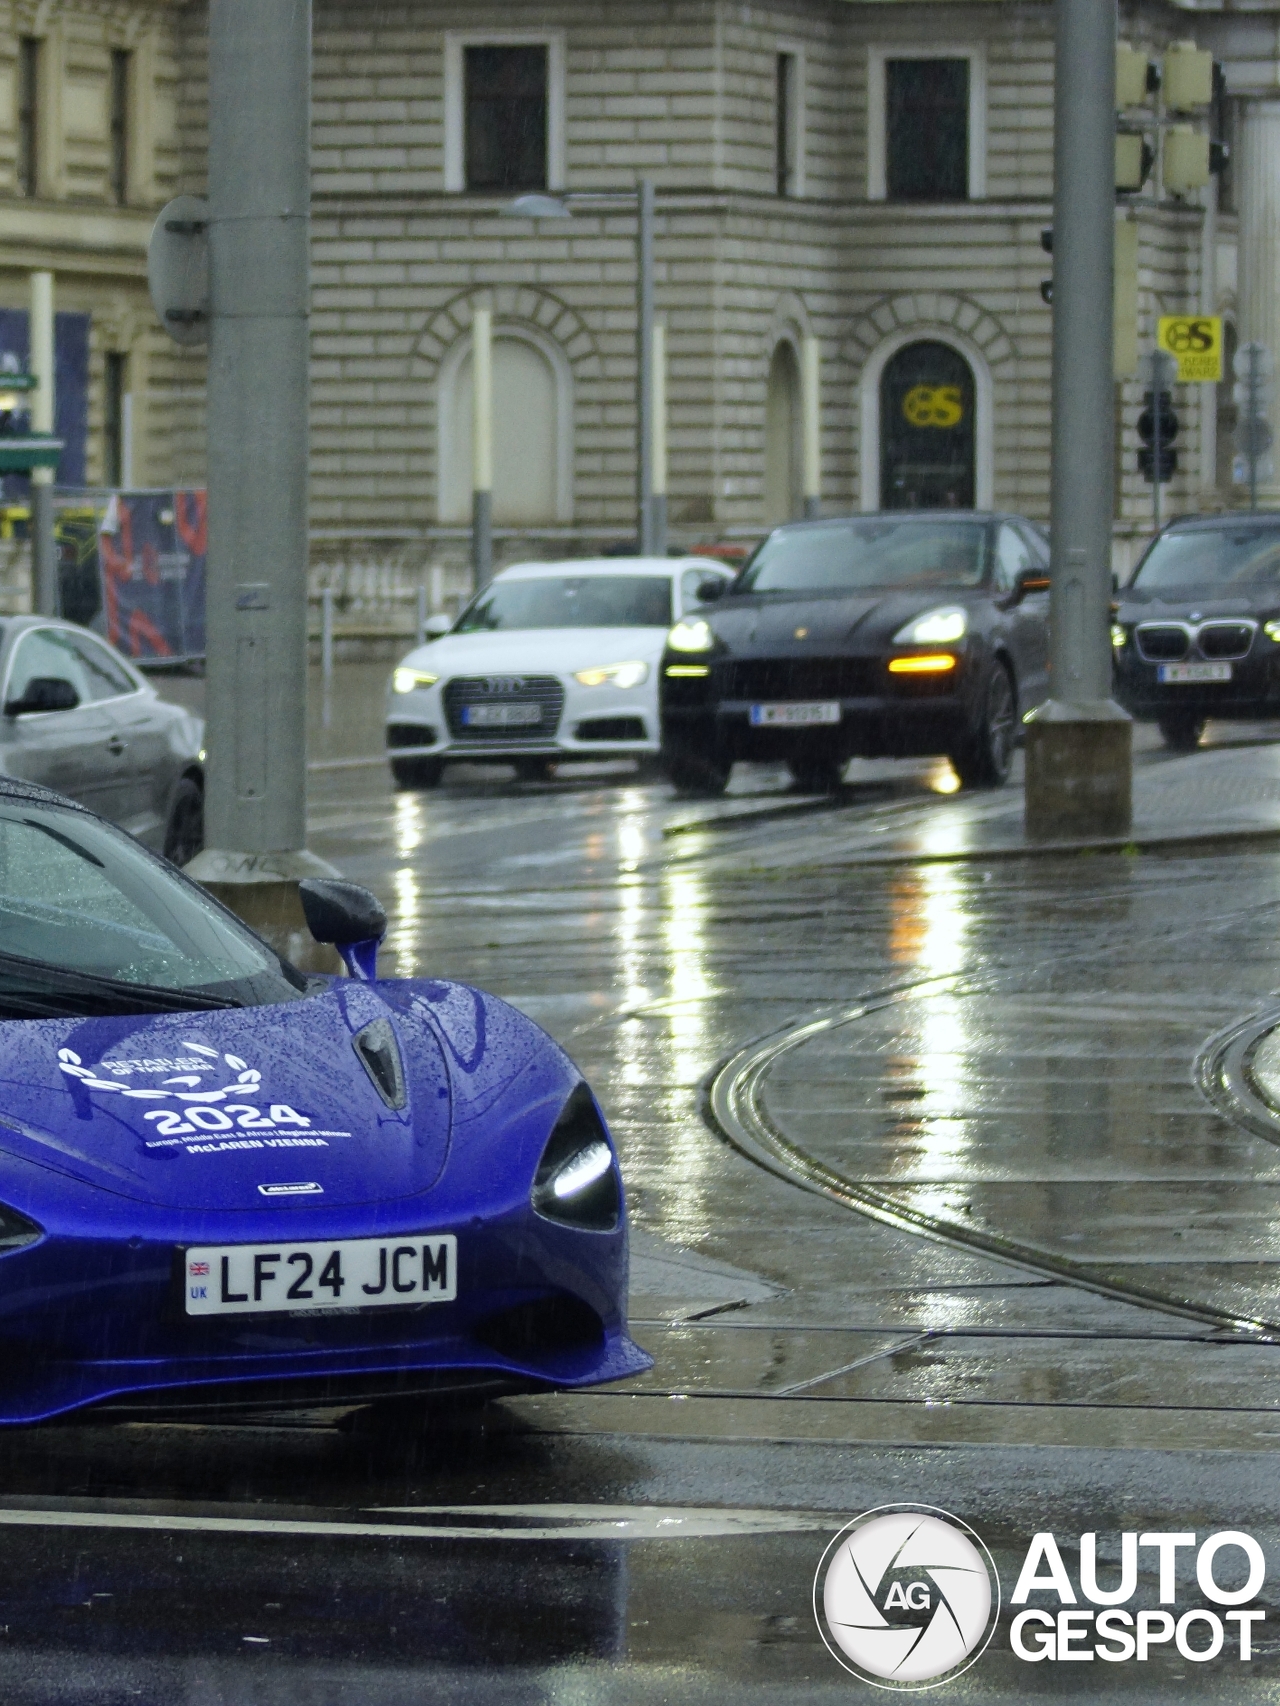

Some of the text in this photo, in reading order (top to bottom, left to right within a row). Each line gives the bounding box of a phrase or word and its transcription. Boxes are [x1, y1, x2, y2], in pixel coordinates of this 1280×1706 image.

[101, 1058, 207, 1069] RETAILER
[144, 1105, 311, 1135] 2024
[186, 1138, 330, 1154] McLAREN VIENNA
[221, 1243, 448, 1303] LF24 JCM
[190, 1286, 208, 1299] UK
